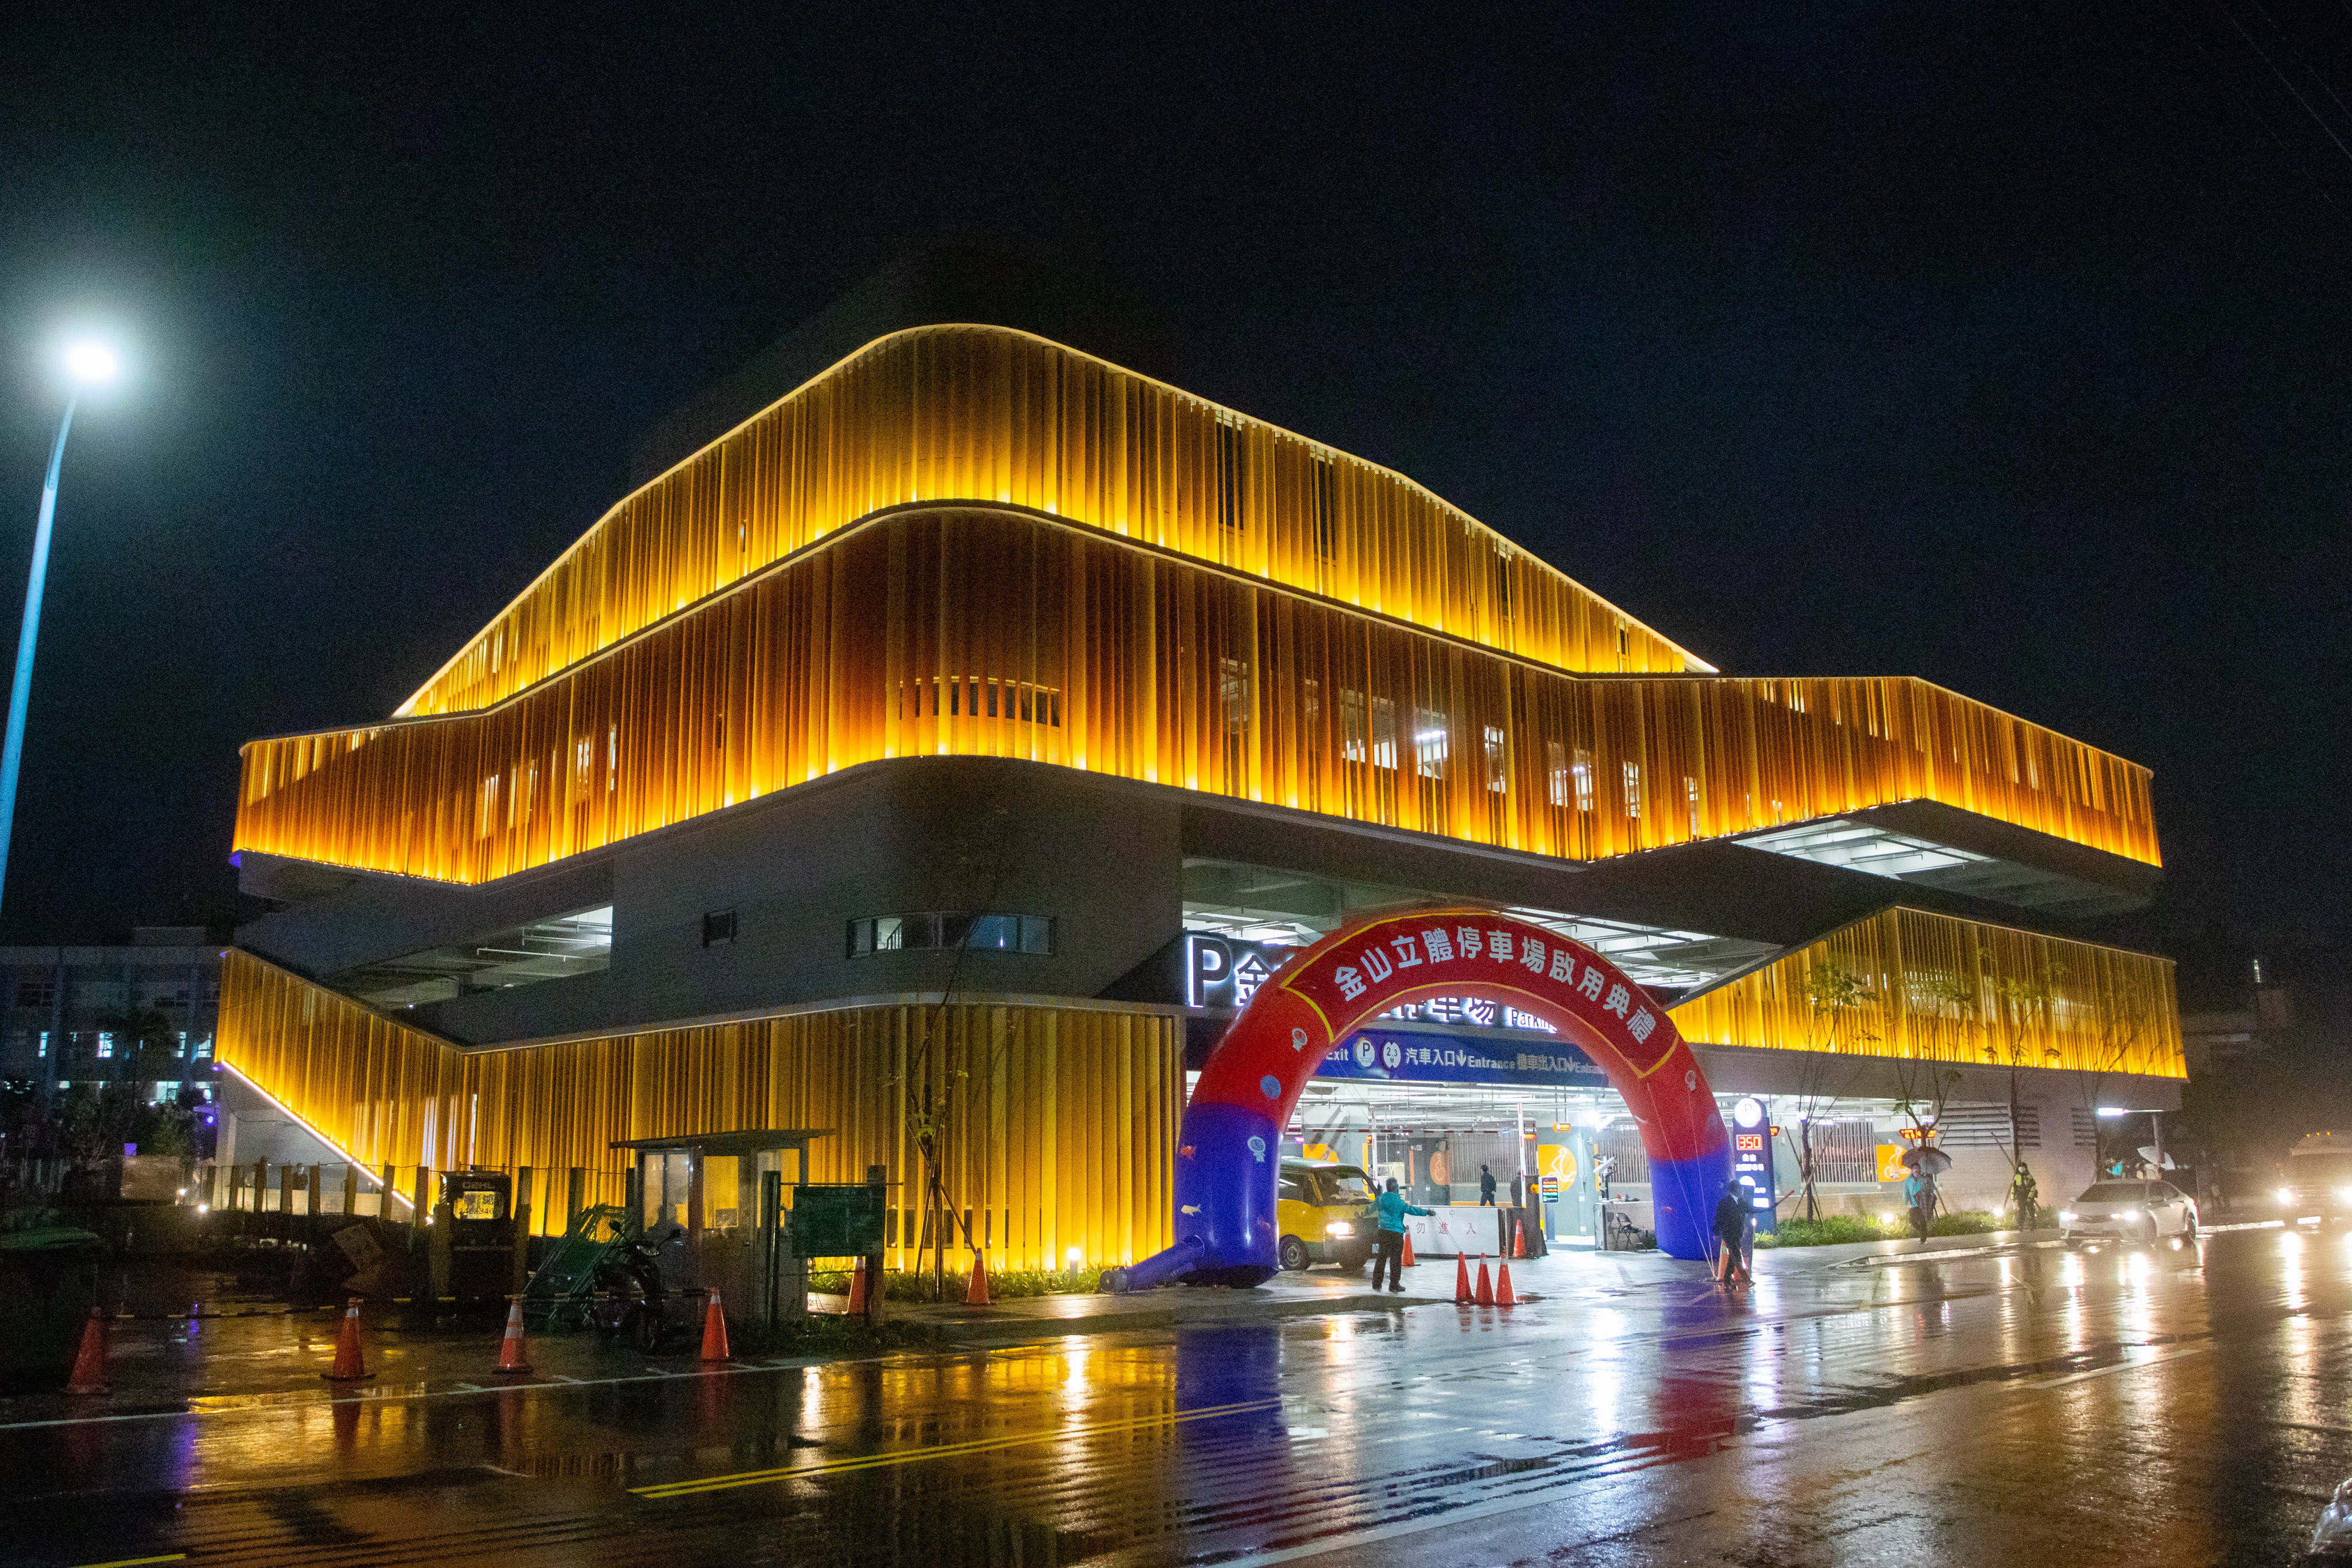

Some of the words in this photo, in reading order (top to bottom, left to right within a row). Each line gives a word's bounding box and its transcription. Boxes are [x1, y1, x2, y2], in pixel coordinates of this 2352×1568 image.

[1193, 936, 1232, 1007] P
[1334, 926, 1657, 1044] 金山立體停車場啟用典禮
[1406, 1047, 1456, 1066] 汽車入口
[1468, 1055, 1515, 1069] Entrance
[1739, 1136, 1760, 1148] 350
[1415, 1221, 1476, 1234] 勿進入
